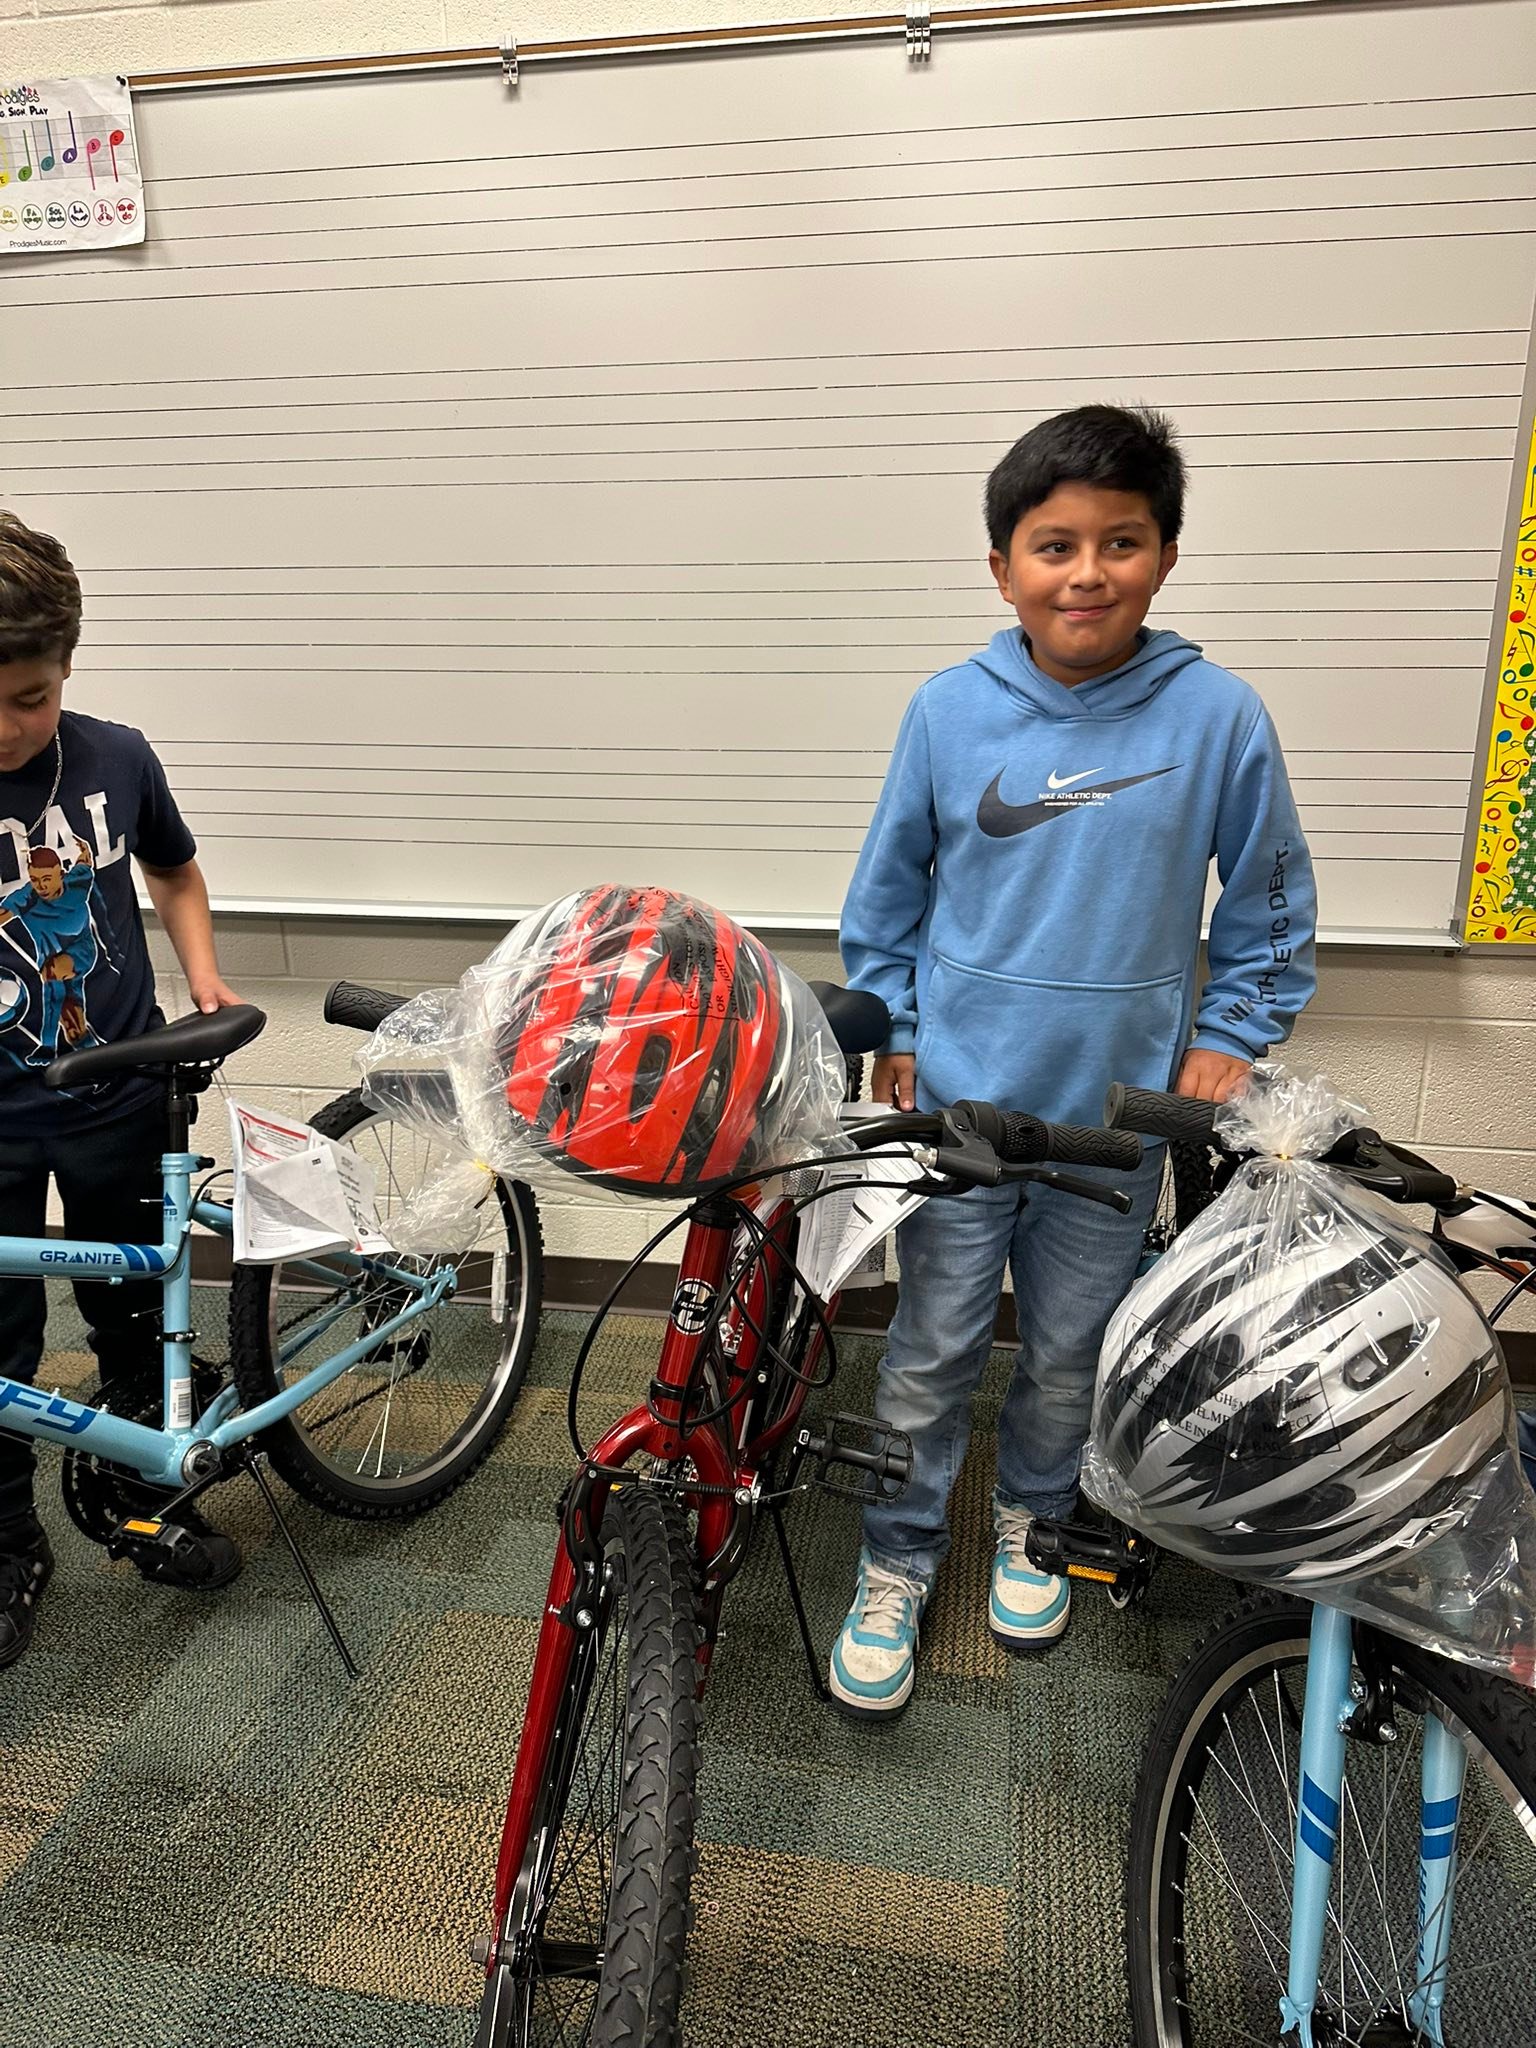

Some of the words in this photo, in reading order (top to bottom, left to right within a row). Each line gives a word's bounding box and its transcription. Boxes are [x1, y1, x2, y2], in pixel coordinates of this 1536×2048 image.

[716, 995, 725, 1012] OR
[40, 1250, 123, 1265] GRANITE
[0, 1381, 98, 1435] FY
